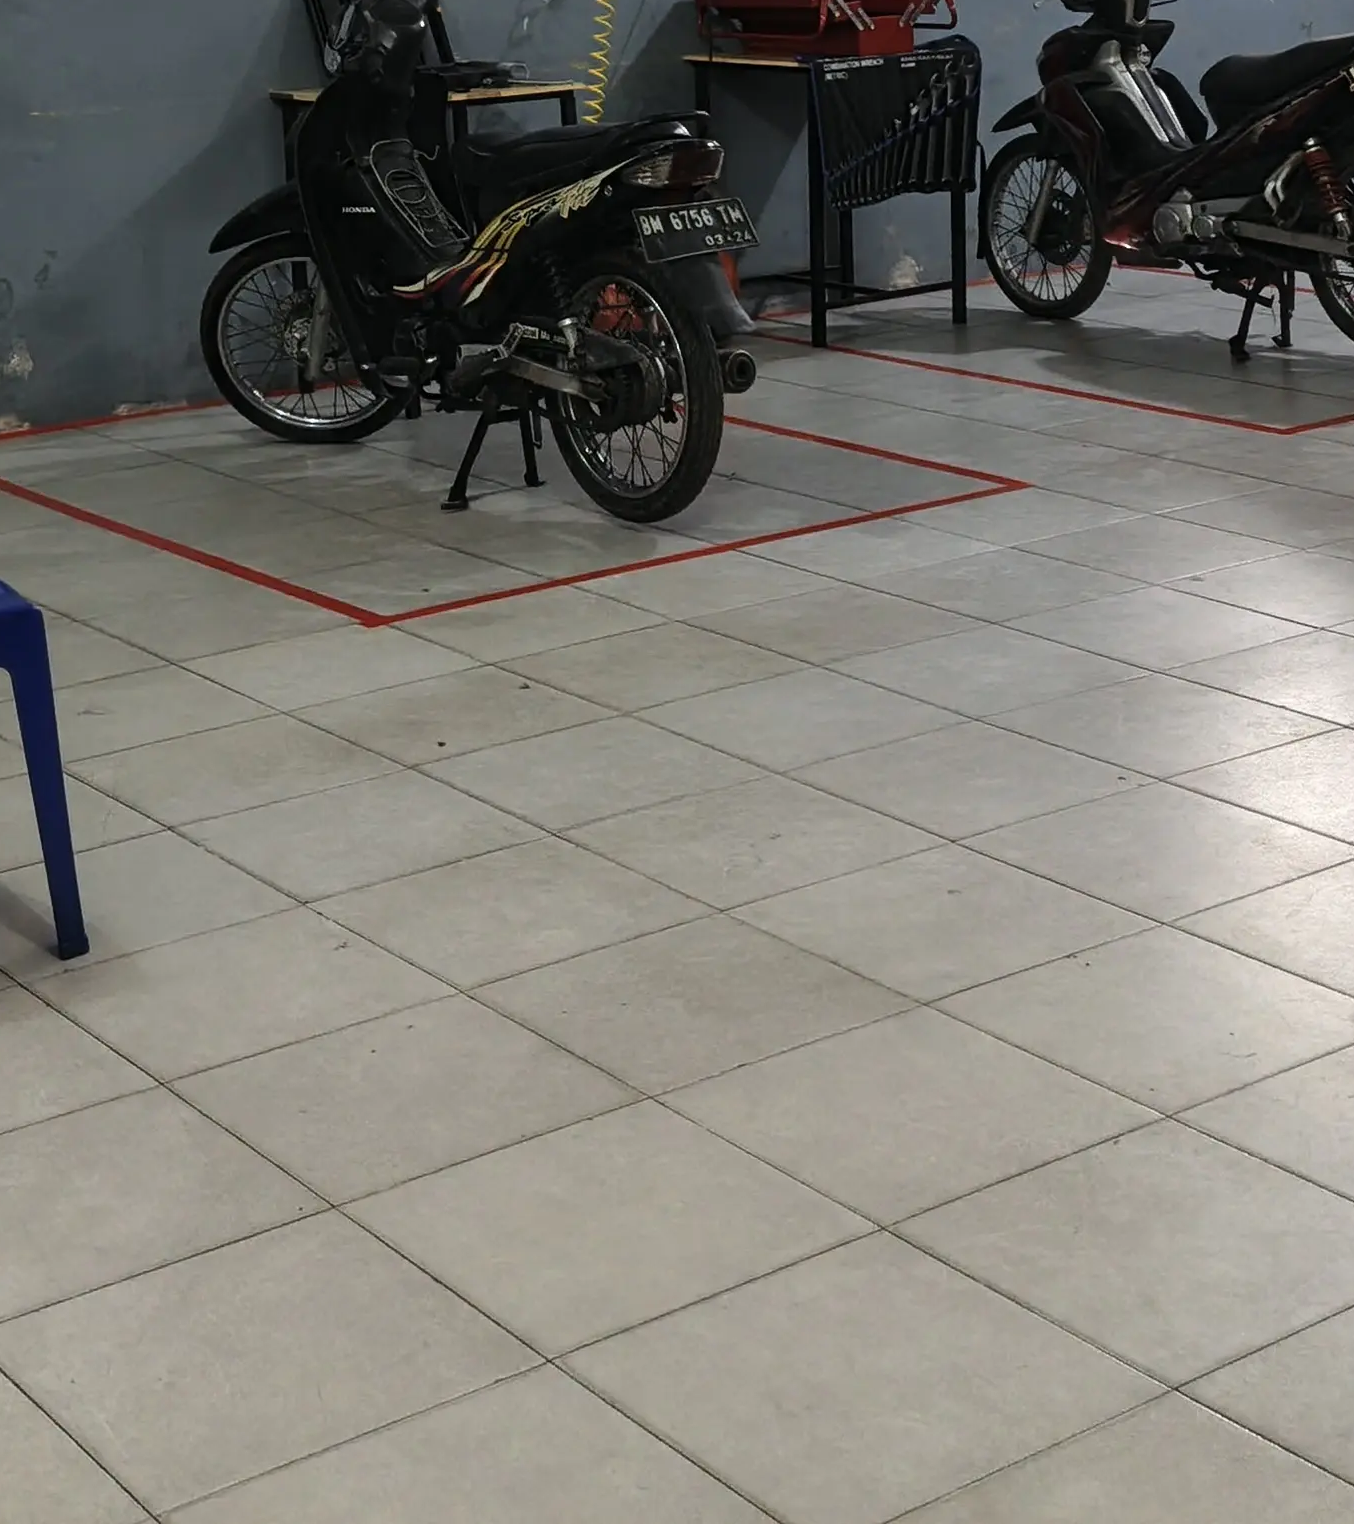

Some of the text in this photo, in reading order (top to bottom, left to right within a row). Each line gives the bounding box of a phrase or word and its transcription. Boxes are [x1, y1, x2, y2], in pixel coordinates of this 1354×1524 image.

[639, 205, 744, 235] BM 6756 TM
